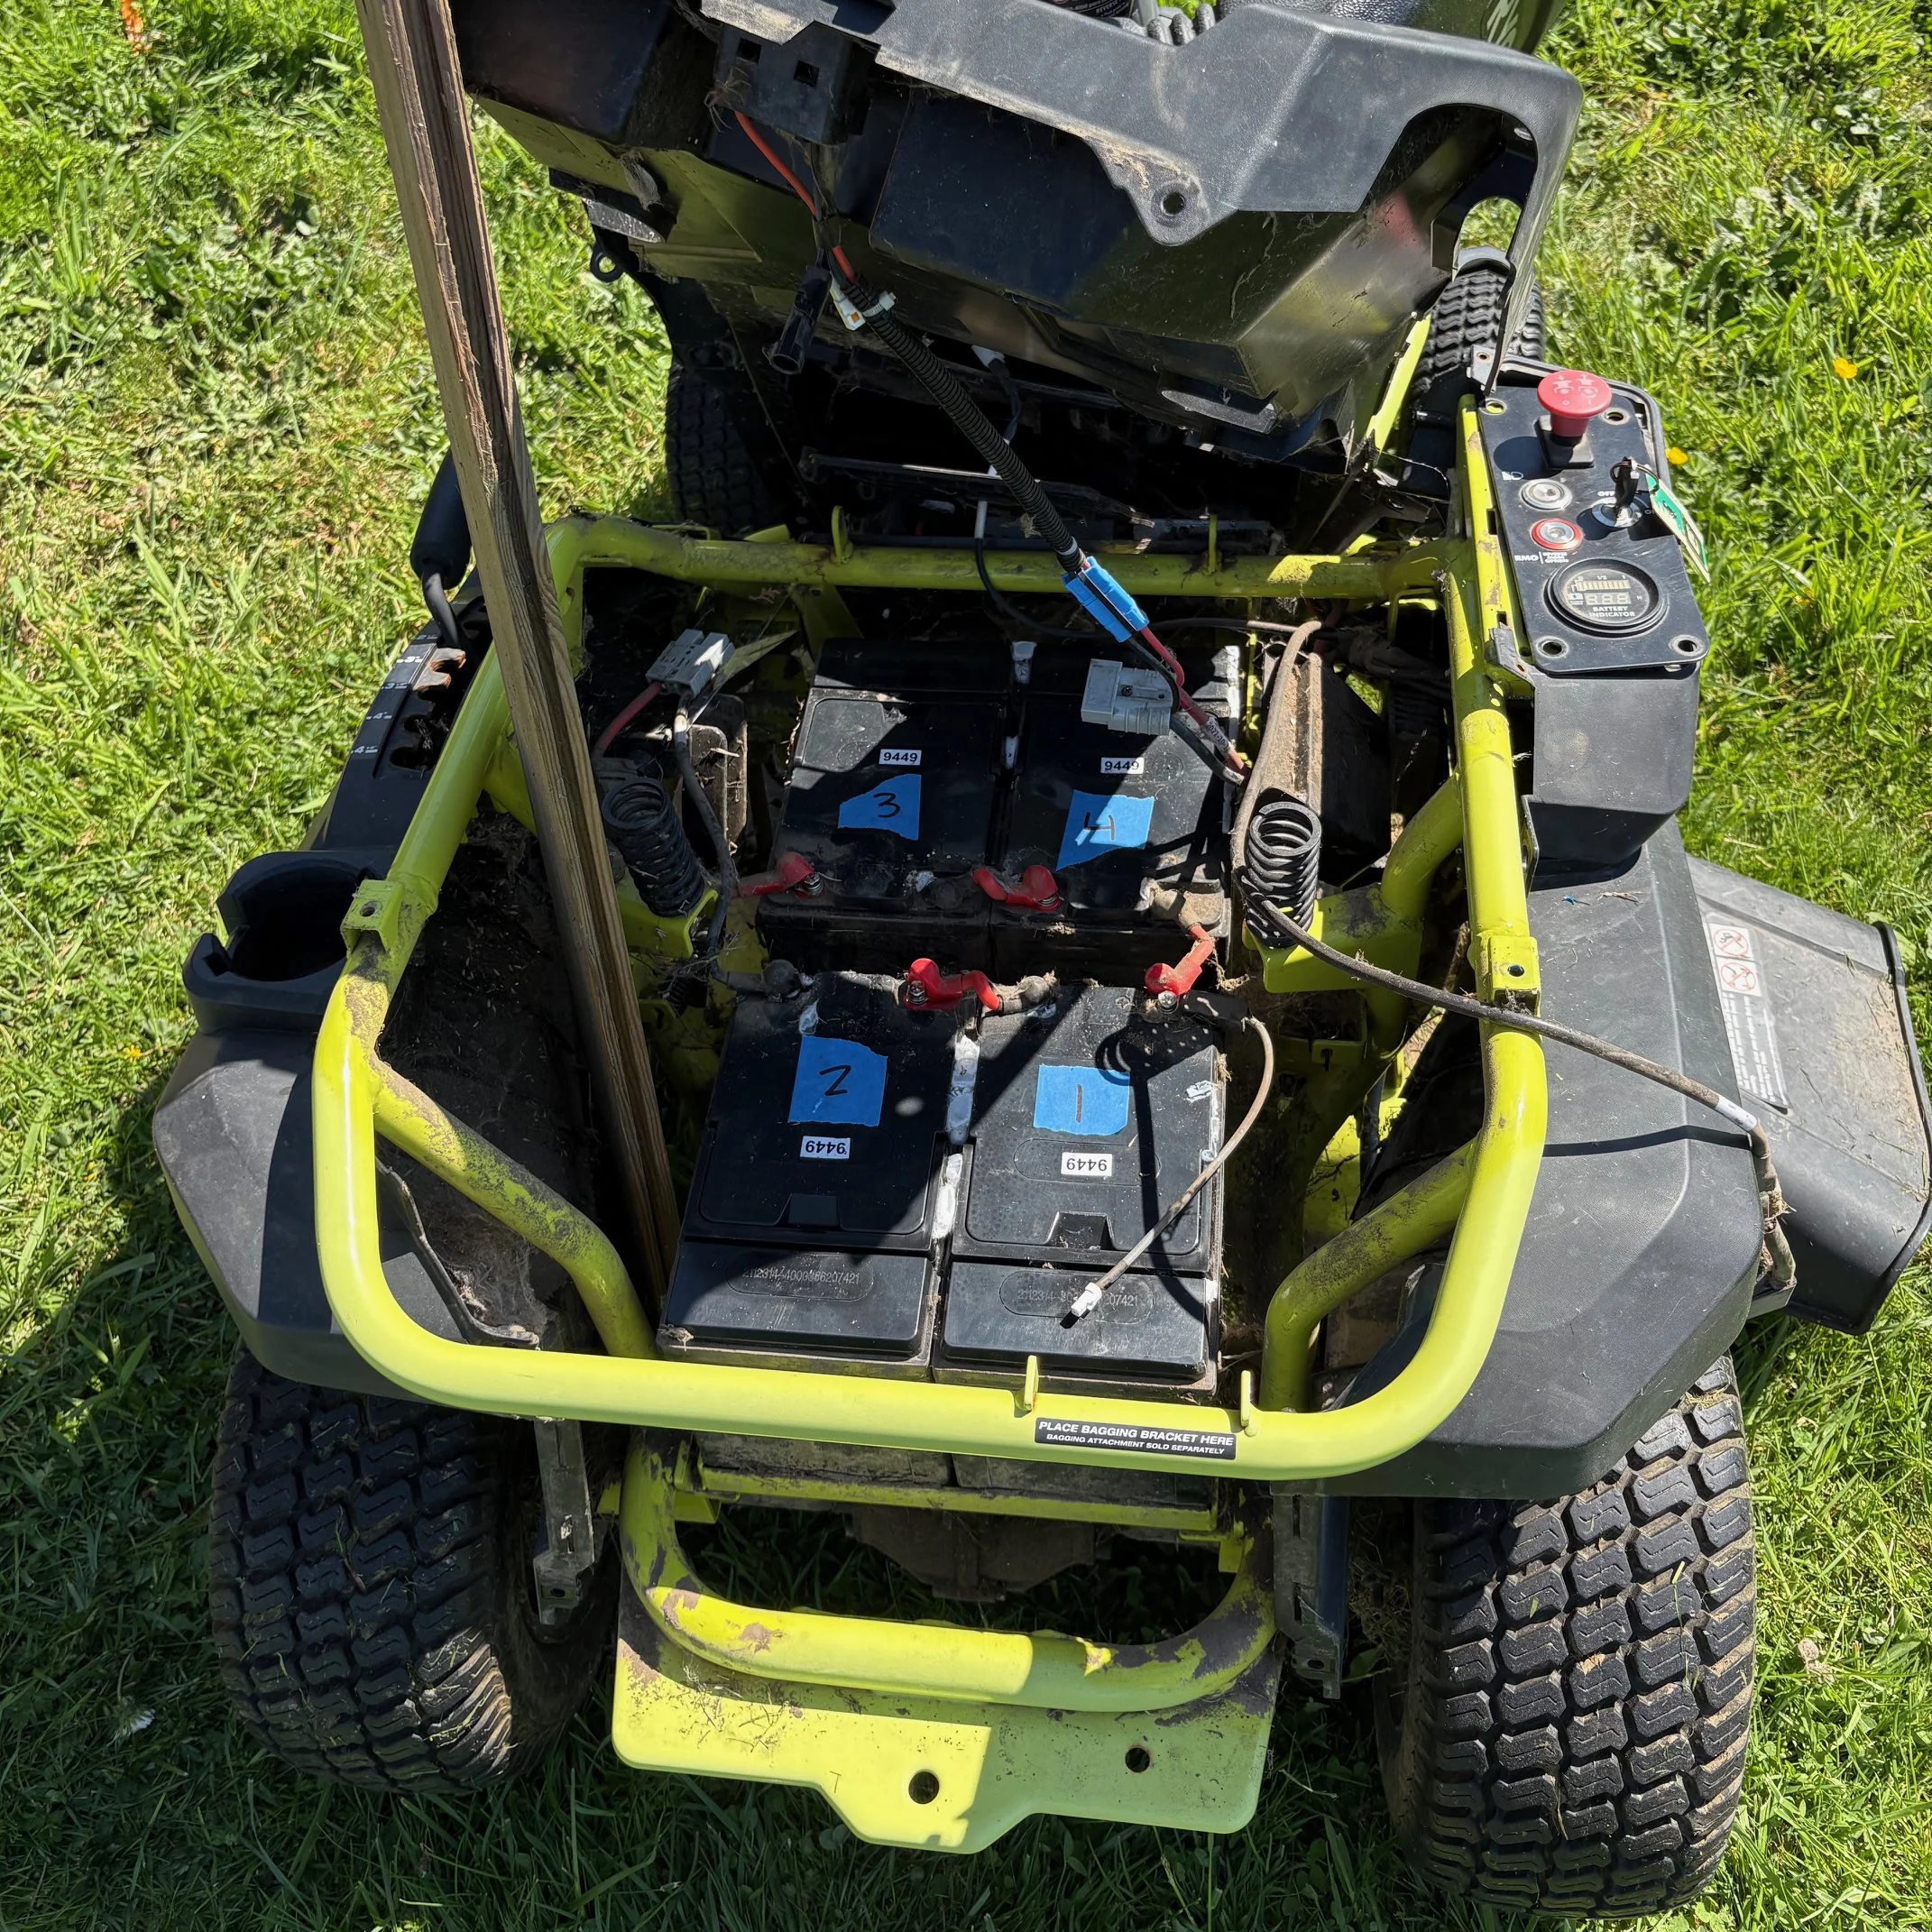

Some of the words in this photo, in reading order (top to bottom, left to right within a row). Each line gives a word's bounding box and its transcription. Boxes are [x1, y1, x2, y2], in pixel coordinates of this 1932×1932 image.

[883, 751, 918, 764] 9449
[1104, 759, 1139, 771] 9449
[873, 792, 900, 818] 3
[1083, 811, 1115, 841] 4
[819, 1064, 851, 1097] 2
[1076, 1084, 1083, 1123] 1
[805, 1139, 846, 1156] 9449
[1066, 1155, 1108, 1173] 9449
[1038, 1421, 1078, 1433] PLACE
[1081, 1424, 1137, 1439] BAGGING
[1140, 1430, 1198, 1443] BRACKET
[1200, 1435, 1234, 1446] HERE
[1046, 1433, 1086, 1443] BAGGING
[1087, 1437, 1145, 1449] ATTACHMENT
[1145, 1441, 1170, 1450] SOLD
[1171, 1444, 1225, 1455] SEPARATELY
